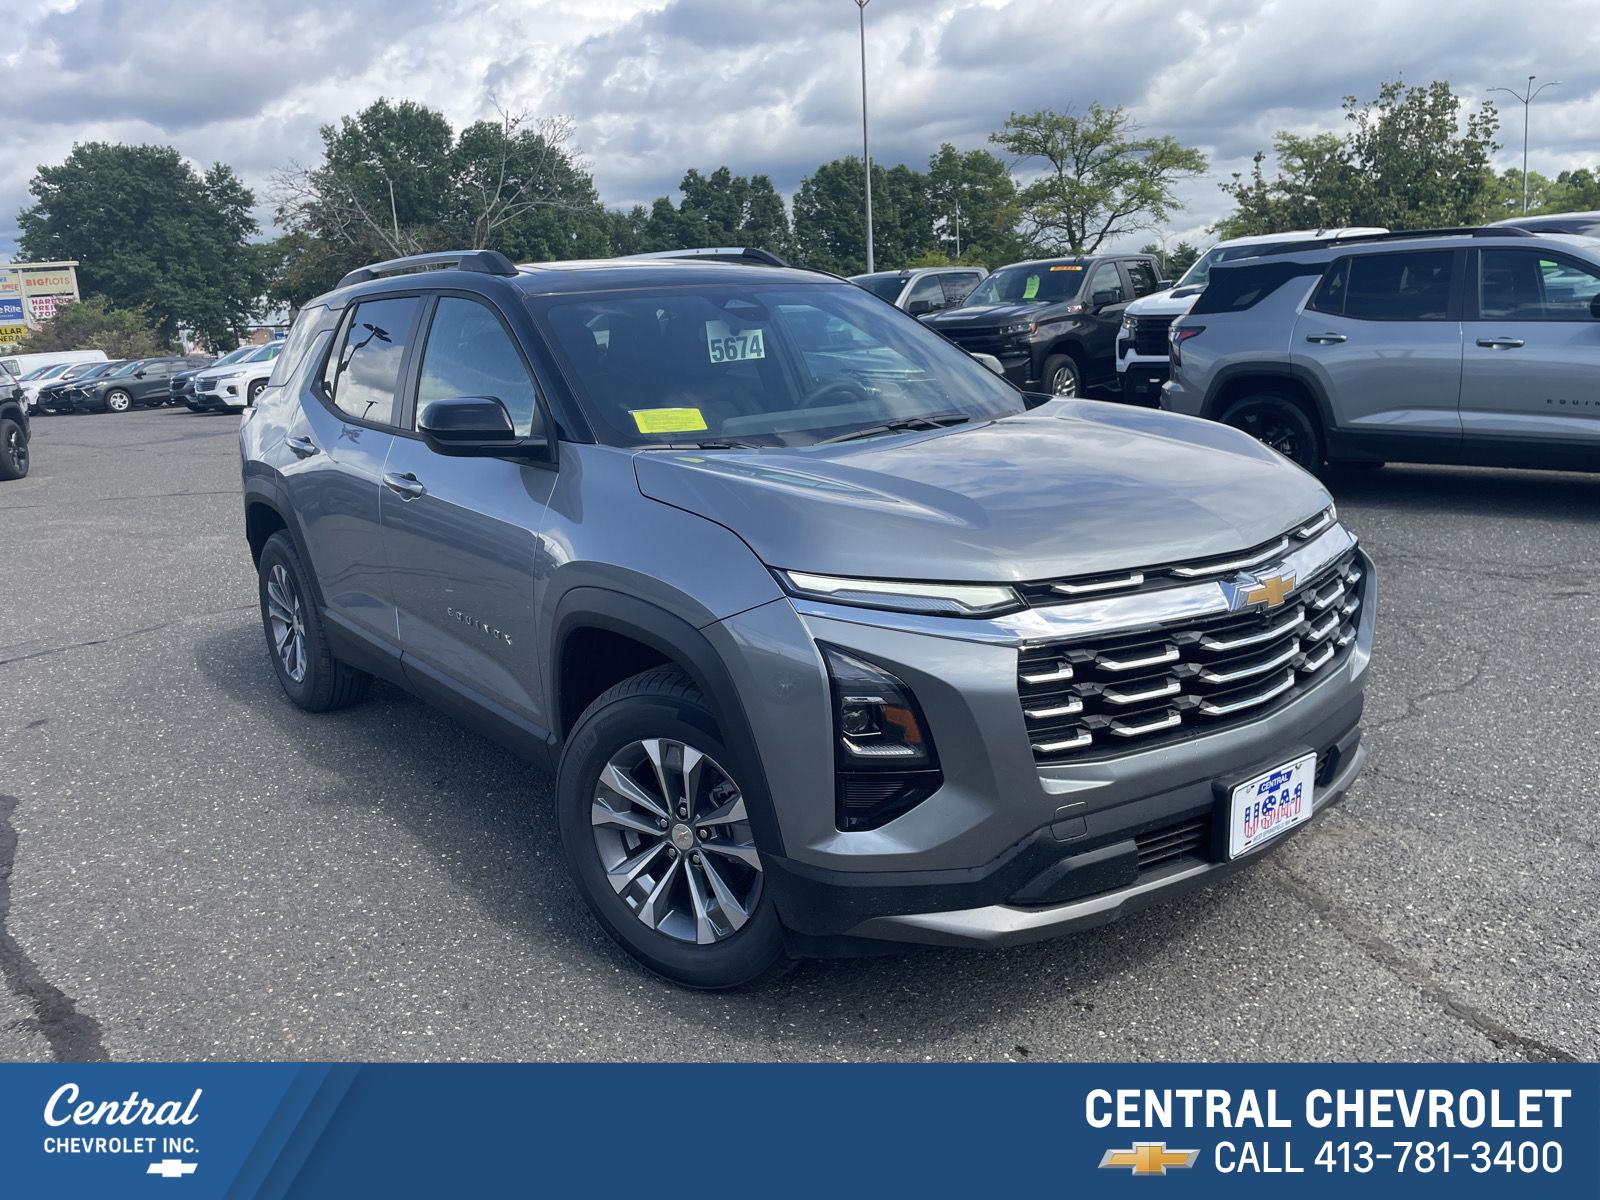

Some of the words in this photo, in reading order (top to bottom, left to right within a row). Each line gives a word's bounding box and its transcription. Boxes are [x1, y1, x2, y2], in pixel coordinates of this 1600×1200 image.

[710, 335, 763, 361] 5674
[447, 607, 513, 646] EQUINOX
[1261, 774, 1289, 792] CENTRAL
